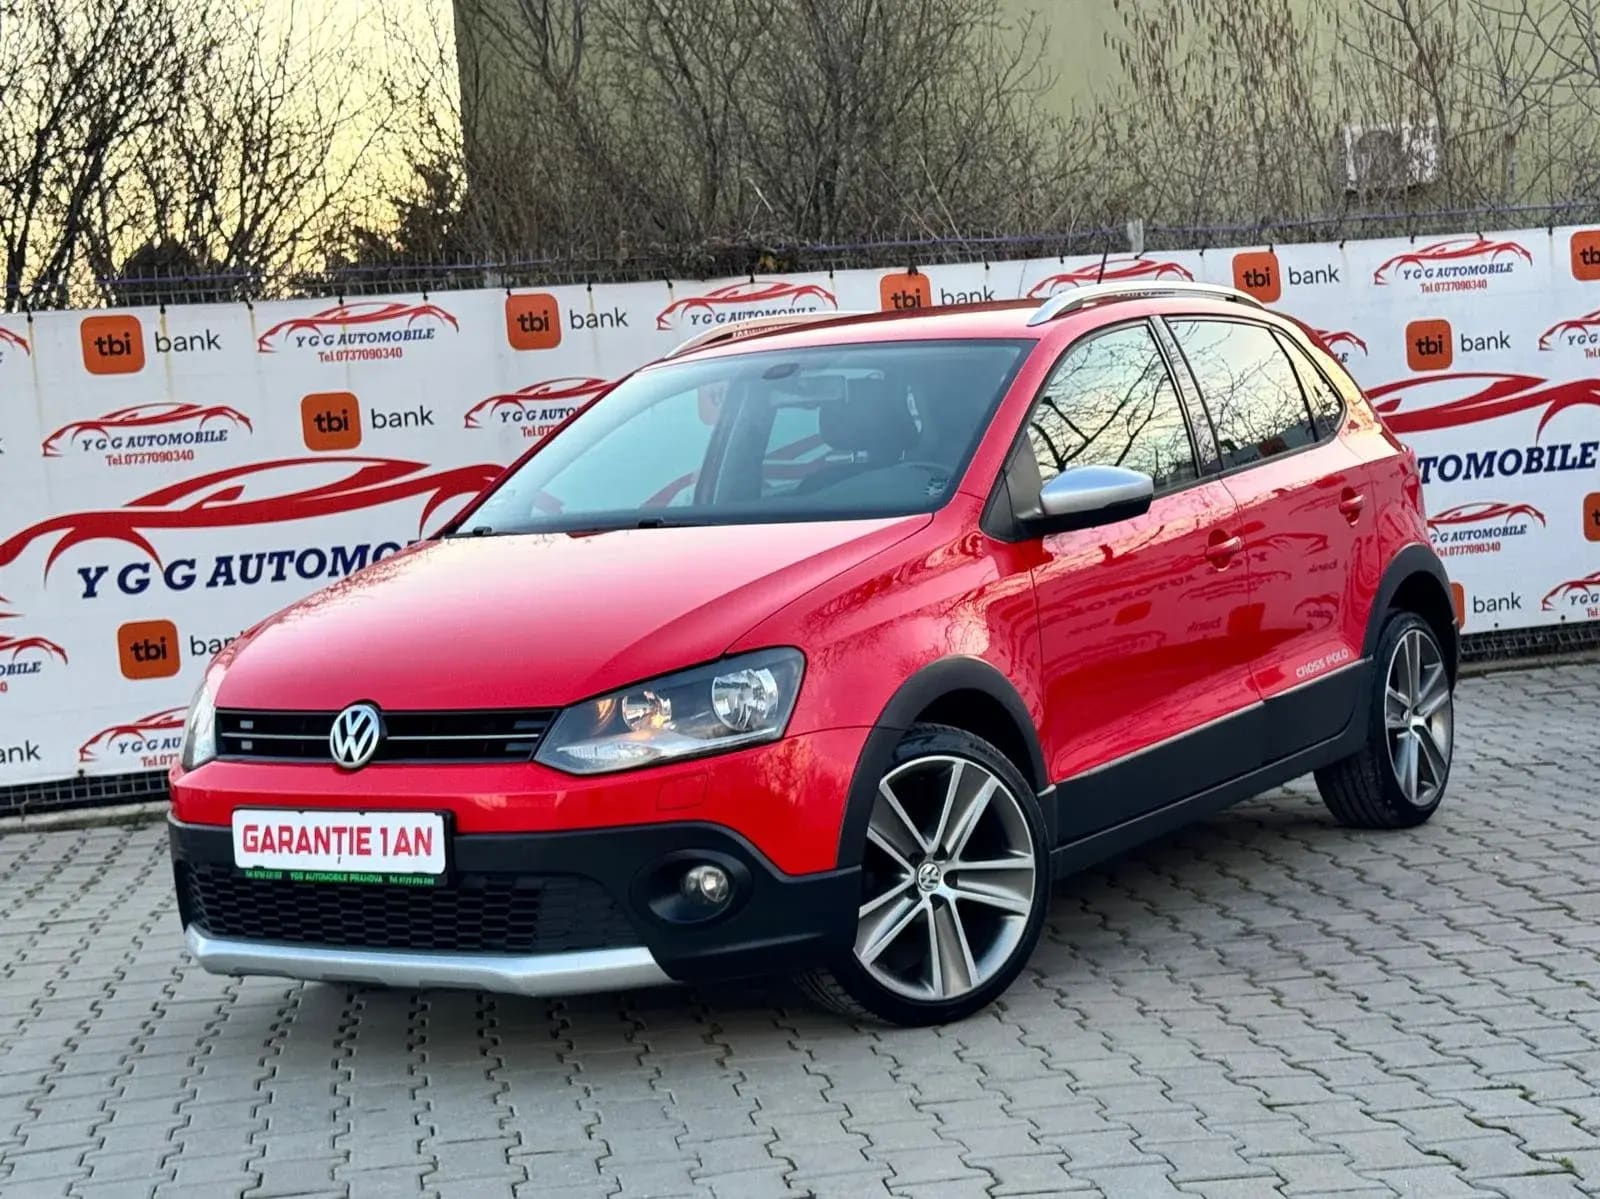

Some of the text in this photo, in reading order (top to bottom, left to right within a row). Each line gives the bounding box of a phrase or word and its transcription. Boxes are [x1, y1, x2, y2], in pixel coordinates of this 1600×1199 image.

[1242, 264, 1339, 288] tbi bank
[1435, 262, 1513, 278] AUTOMOBILE
[891, 284, 995, 309] tbi bank
[516, 307, 629, 333] tbi bank
[94, 329, 221, 357] tbi bank
[337, 328, 436, 345] AUTOMOBILE
[1415, 331, 1511, 356] tbi bank
[318, 347, 403, 363] Tel.0737090340
[314, 405, 435, 434] tbi bank
[539, 406, 580, 420] AUTO
[126, 429, 229, 449] AUTOMOBILE
[105, 450, 194, 467] Tel.0737090340
[1418, 441, 1600, 484] TOMOBILE
[1451, 524, 1528, 542] AUTOMOBILE
[77, 540, 421, 599] Y G G AUTOMO
[1473, 592, 1522, 613] bank
[130, 636, 167, 663] tbi
[1296, 648, 1349, 678] CROSS POLO
